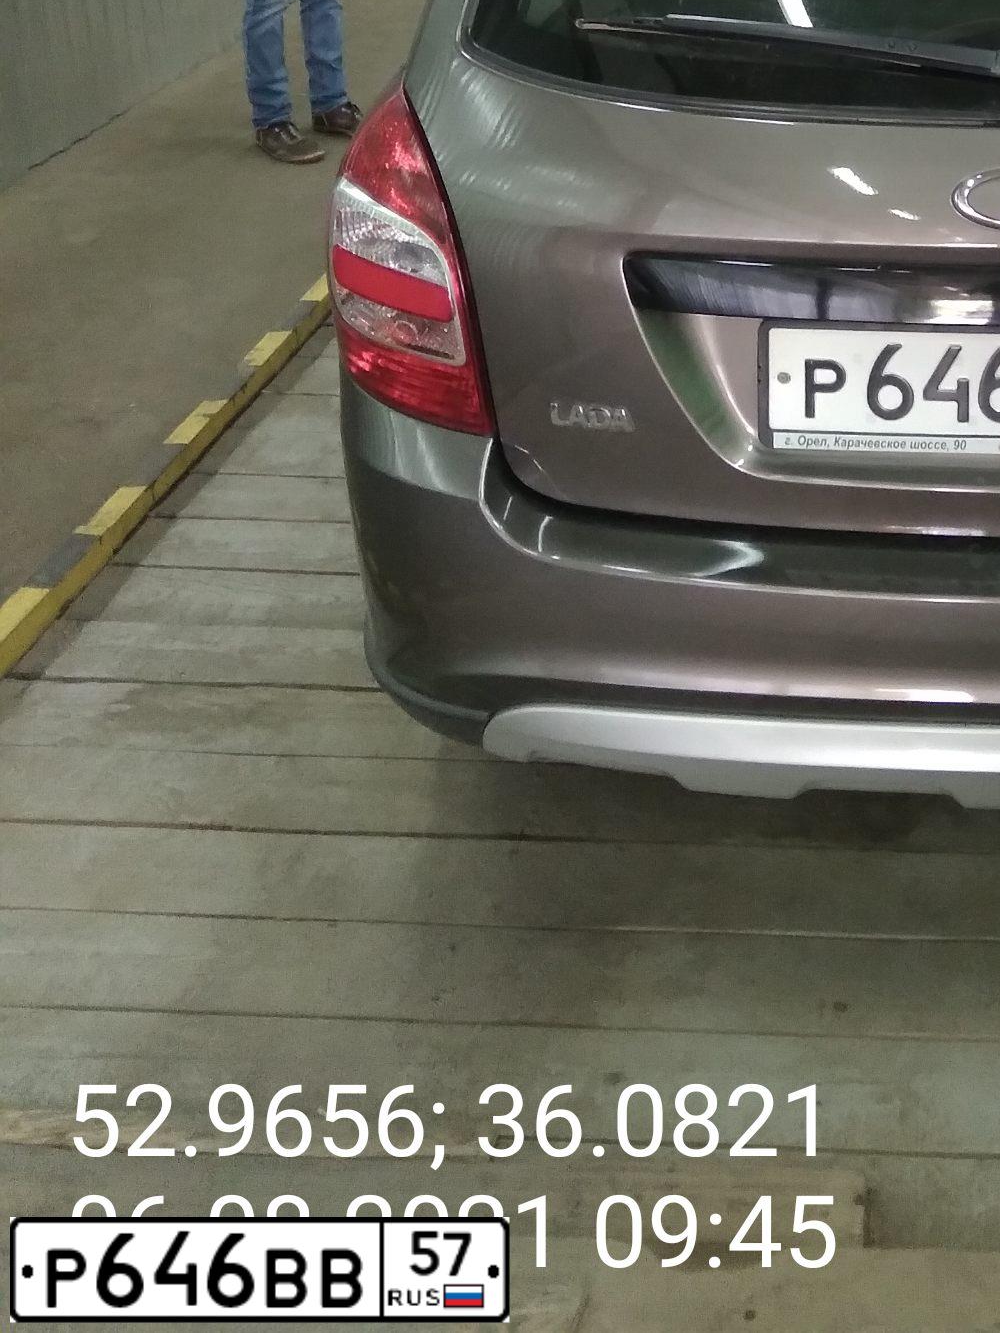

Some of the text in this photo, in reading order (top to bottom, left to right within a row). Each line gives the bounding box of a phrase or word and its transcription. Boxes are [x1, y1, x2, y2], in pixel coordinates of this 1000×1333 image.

[833, 436, 906, 450] Карачевское
[910, 440, 950, 451] шоссе,
[953, 439, 966, 451] 90
